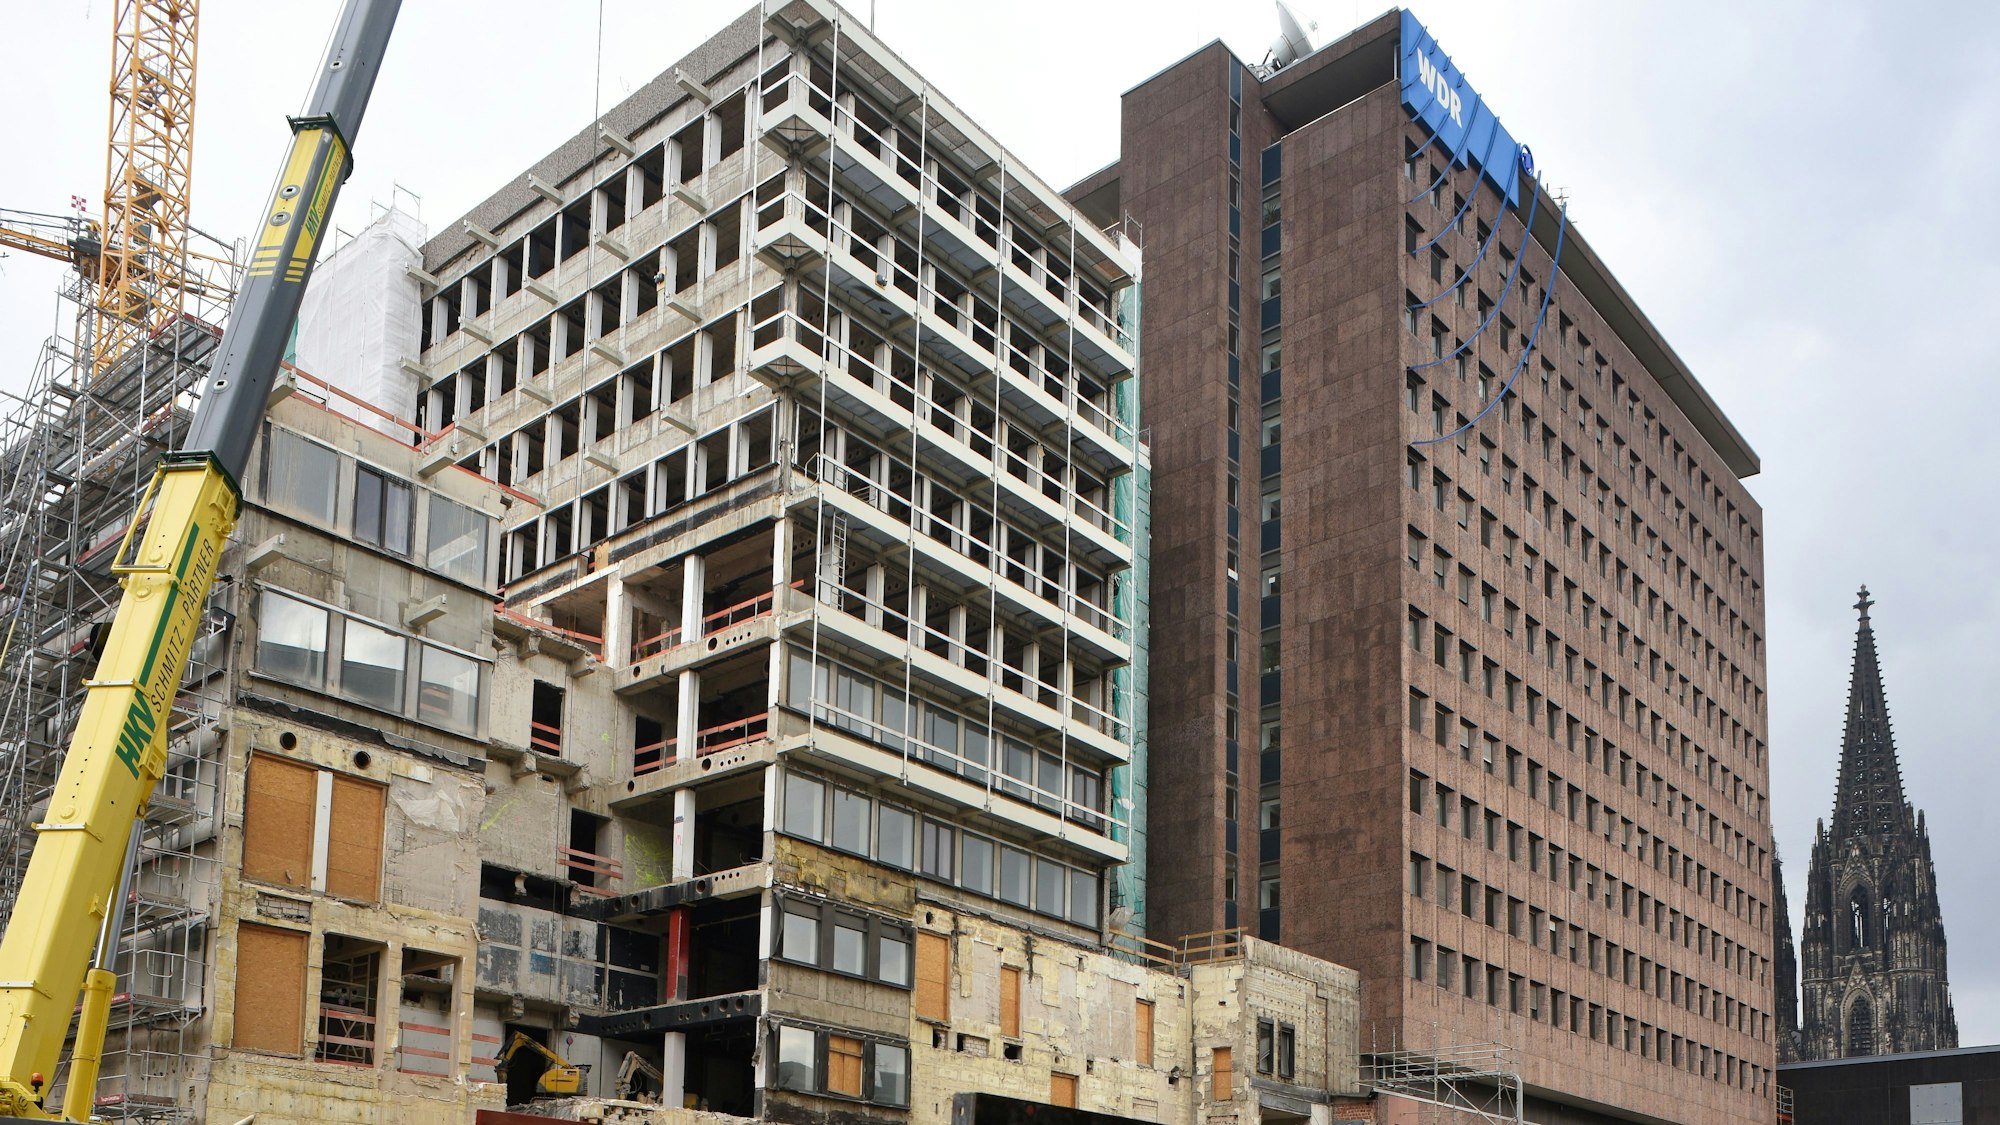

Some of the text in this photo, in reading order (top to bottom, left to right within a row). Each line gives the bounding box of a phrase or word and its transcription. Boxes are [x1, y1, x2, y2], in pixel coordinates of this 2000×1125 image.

[1417, 47, 1462, 129] WDR
[115, 690, 156, 780] HKV
[151, 628, 185, 713] SCHMITZ
[182, 538, 215, 621] PARTNER
